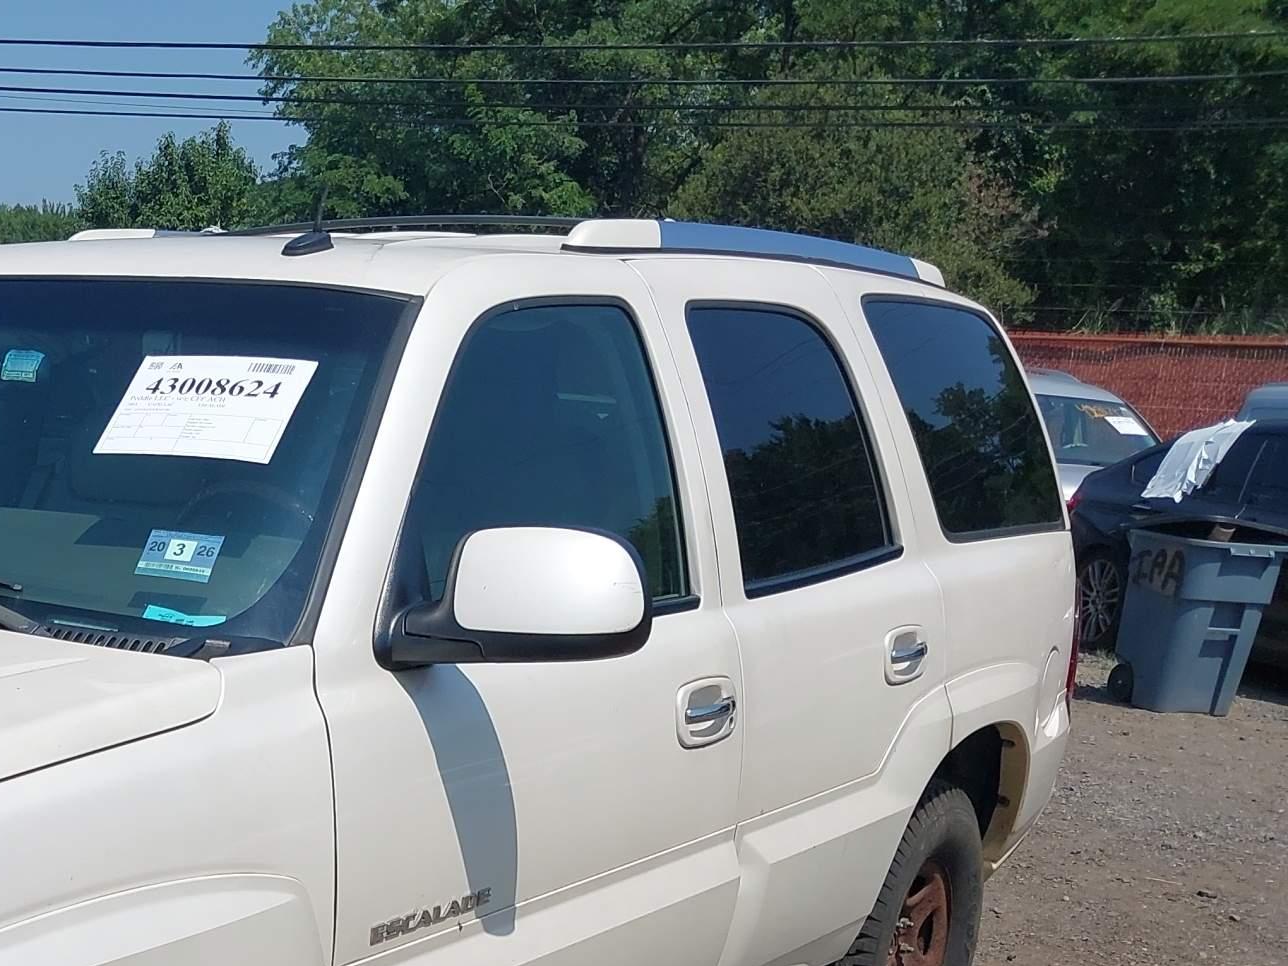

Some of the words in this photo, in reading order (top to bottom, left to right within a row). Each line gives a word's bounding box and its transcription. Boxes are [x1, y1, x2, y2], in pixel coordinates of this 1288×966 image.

[145, 377, 282, 398] 43008624
[149, 541, 166, 552] 20
[173, 543, 186, 556] 3
[197, 545, 215, 557] 26
[1132, 549, 1185, 591] IAA
[369, 887, 492, 946] ESCALADE
